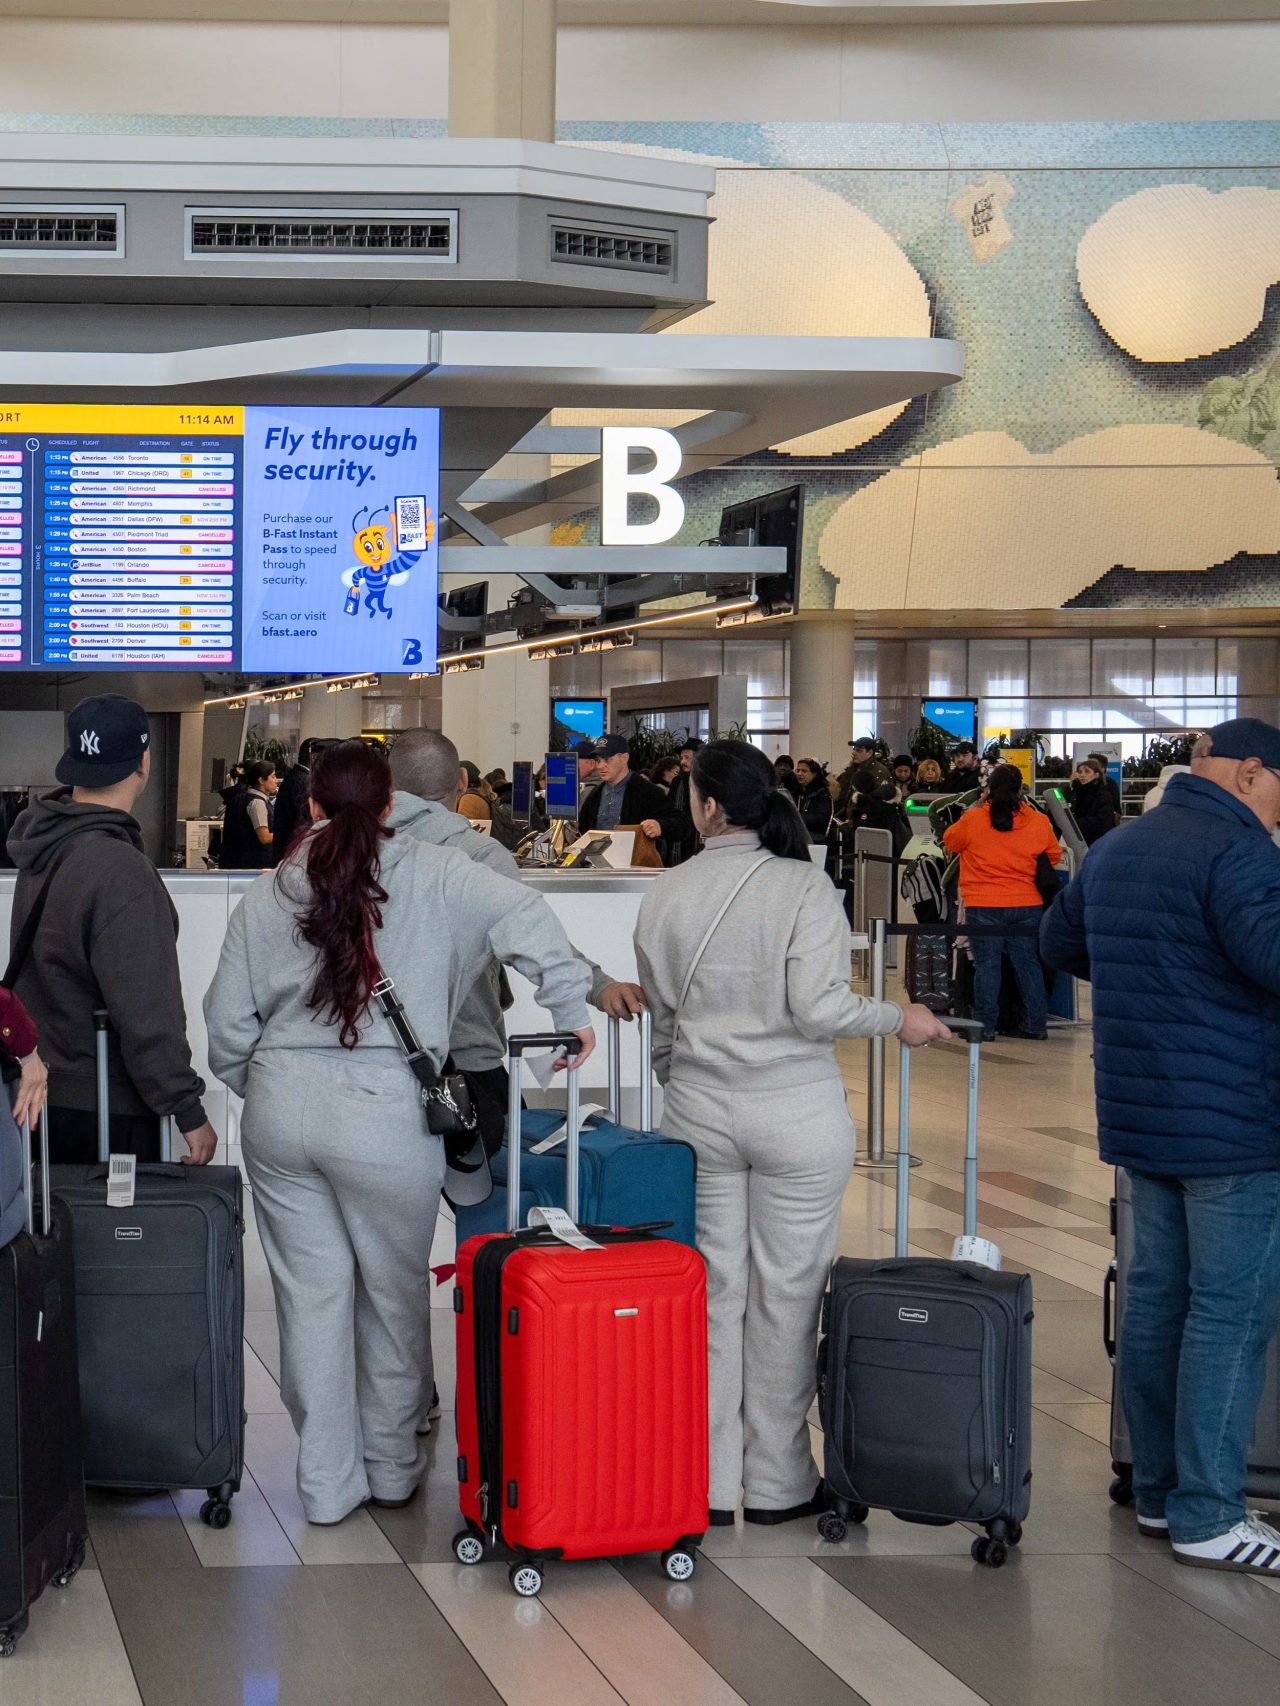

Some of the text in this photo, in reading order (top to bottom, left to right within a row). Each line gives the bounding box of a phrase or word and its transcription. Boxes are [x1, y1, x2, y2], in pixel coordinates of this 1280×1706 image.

[180, 415, 234, 424] 11:14 AM
[265, 426, 417, 457] Fly through
[264, 459, 376, 487] security.
[602, 427, 685, 545] B
[263, 514, 333, 524] Purchase our
[263, 529, 338, 539] B-Fast Instant
[263, 544, 337, 556] Pass to speed
[263, 560, 305, 571] through
[262, 575, 307, 586] security.
[262, 611, 327, 621] Scan or visit
[262, 627, 318, 637] bfast.aero
